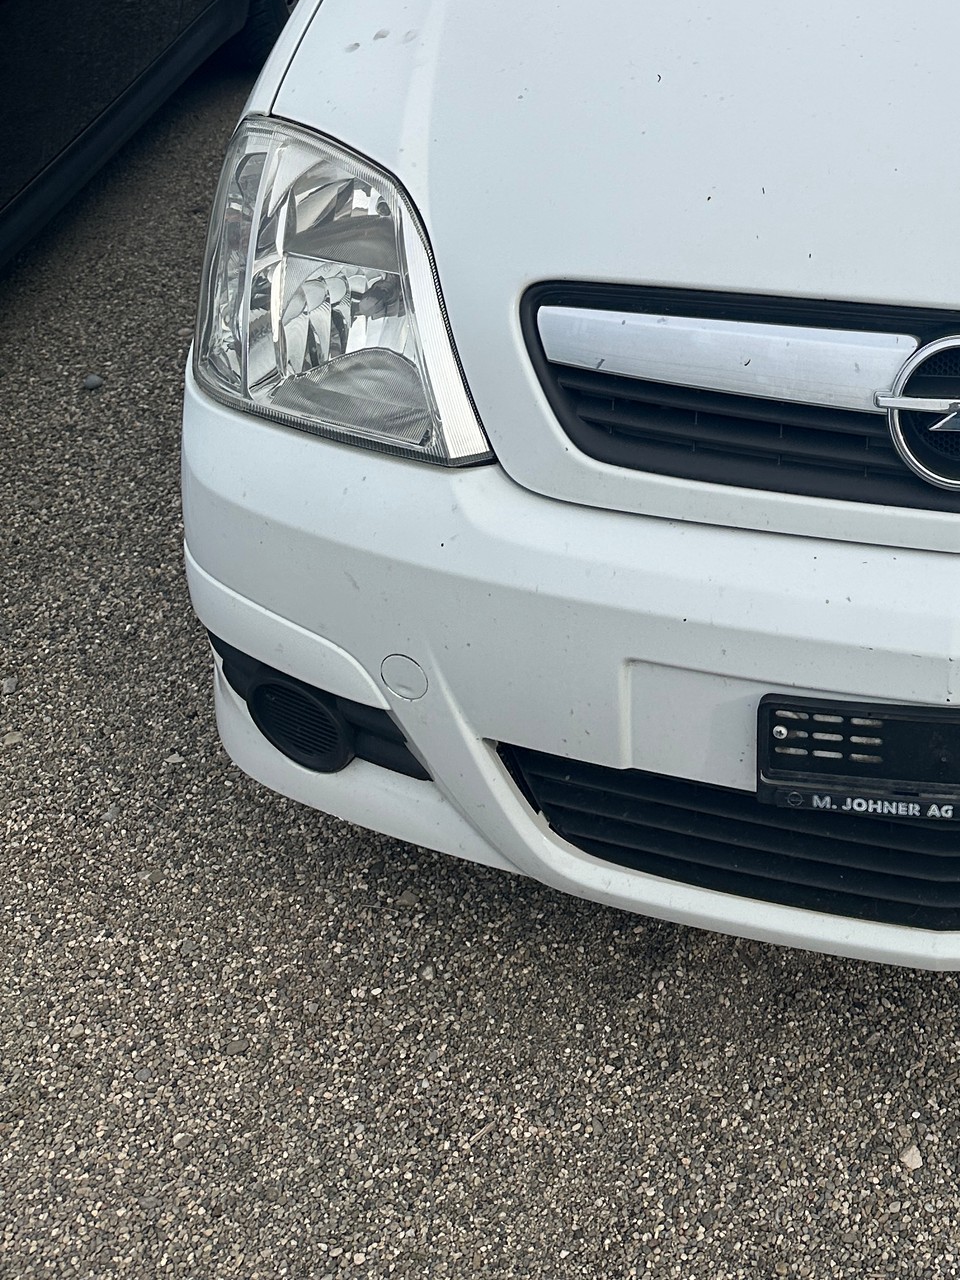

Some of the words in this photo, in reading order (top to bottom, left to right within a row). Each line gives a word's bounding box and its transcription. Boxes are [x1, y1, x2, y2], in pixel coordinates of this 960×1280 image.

[812, 794, 838, 810] M.
[841, 797, 921, 817] JOHNER
[926, 803, 954, 819] AG
